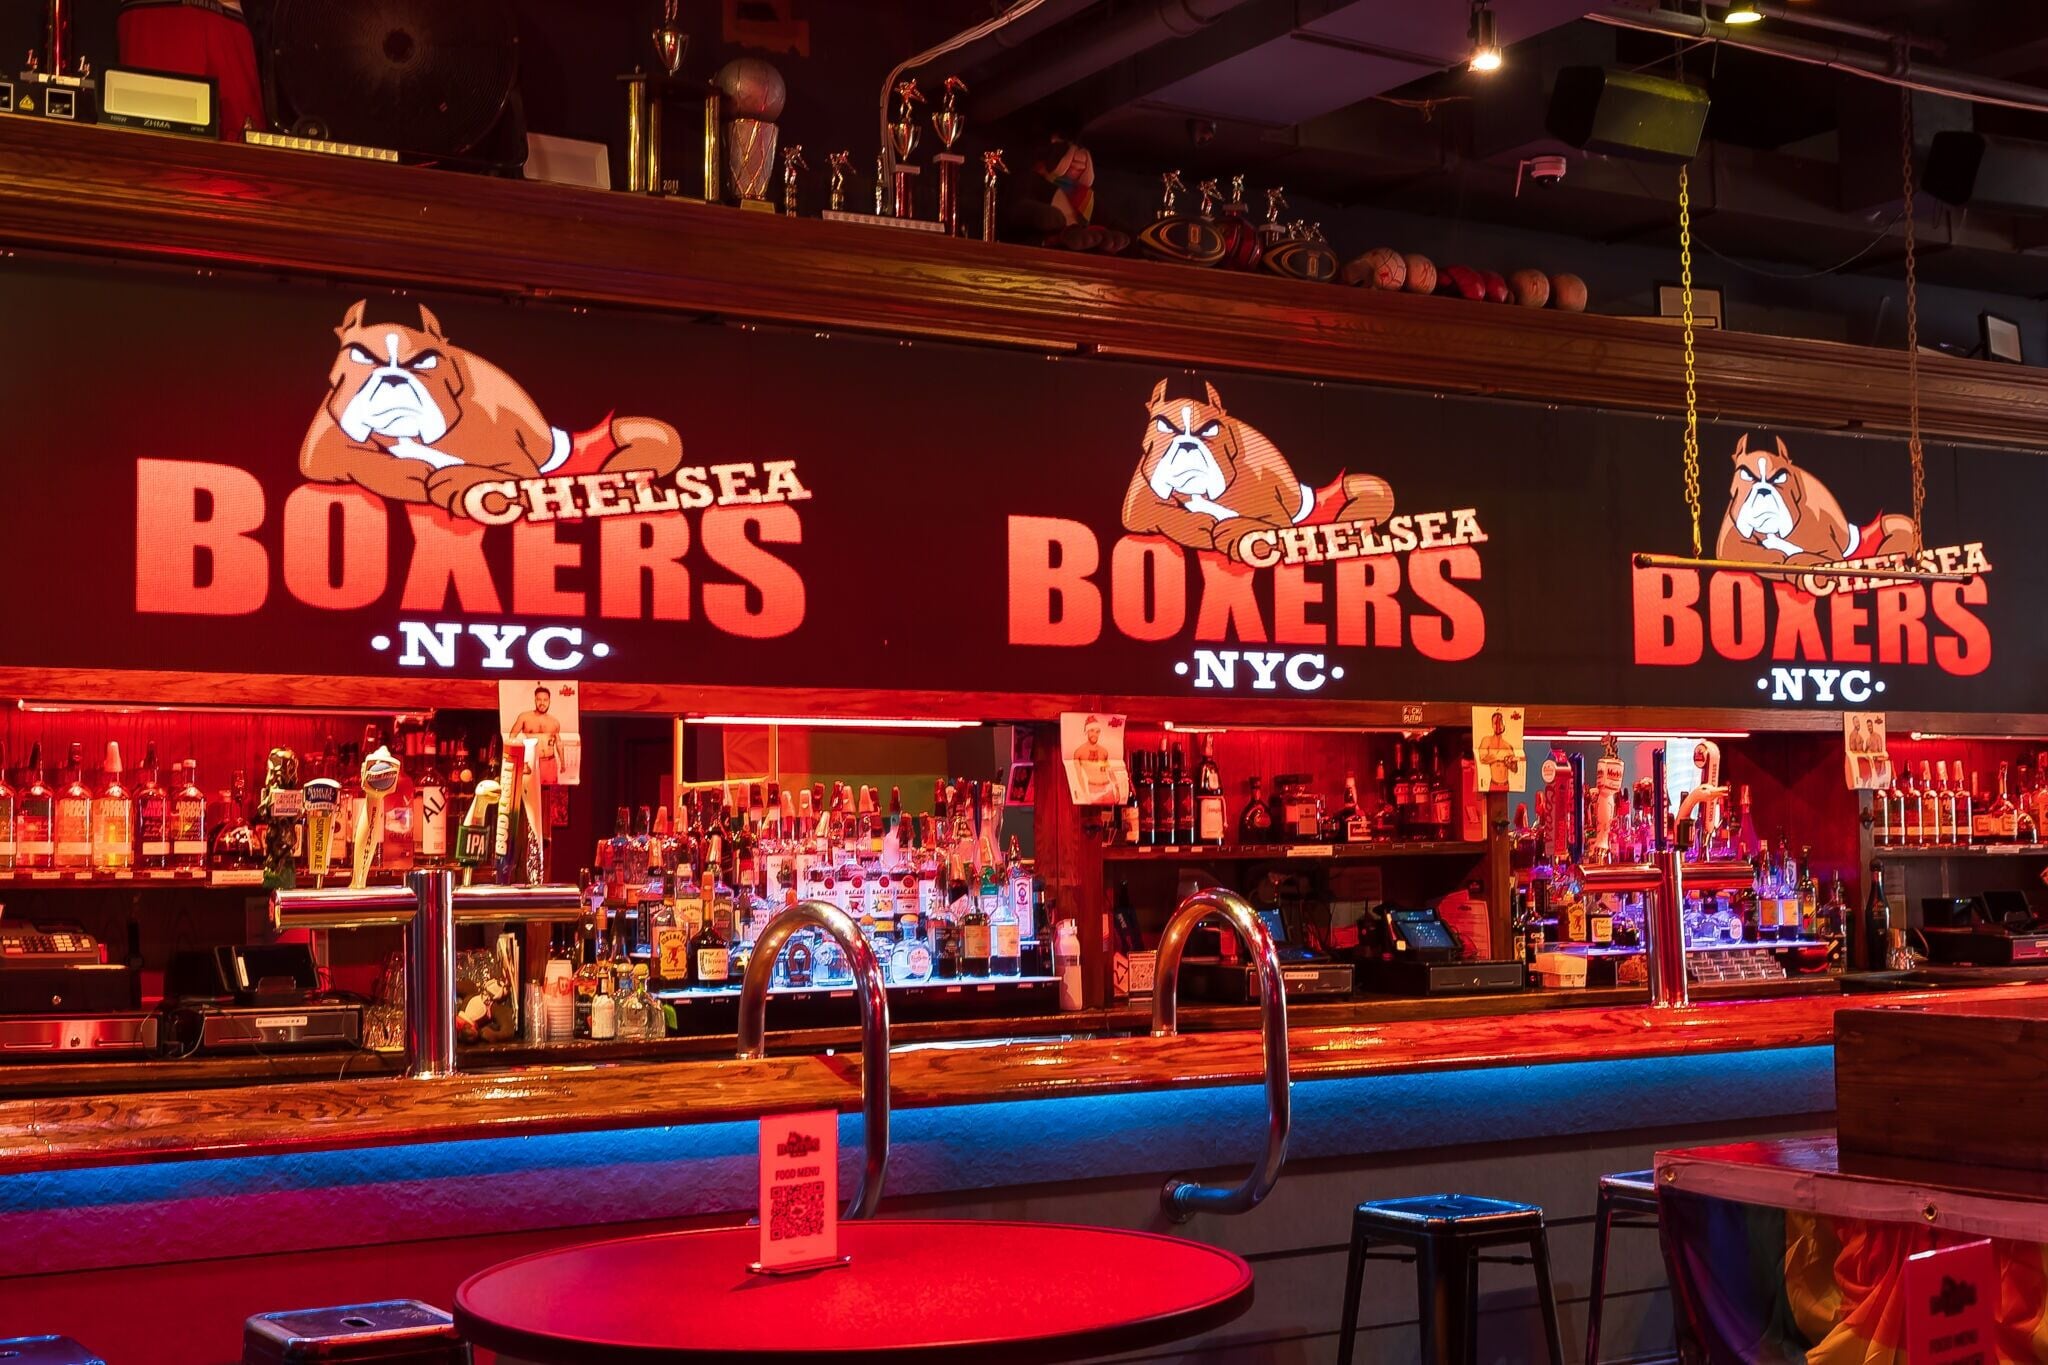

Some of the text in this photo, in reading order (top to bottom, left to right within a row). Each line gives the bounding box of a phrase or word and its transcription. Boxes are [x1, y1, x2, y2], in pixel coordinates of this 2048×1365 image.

[464, 460, 812, 526] CHELSEA
[136, 457, 805, 638] BOXERS
[1238, 508, 1488, 568] CHELSEA
[1008, 515, 1485, 661] BOXERS
[1632, 553, 1992, 677] BOXERS
[398, 621, 585, 670] NYC
[1192, 650, 1328, 691] NYC
[1771, 668, 1872, 702] NYC
[495, 760, 515, 856] BUD LIGHT
[465, 833, 485, 855] IPA
[775, 1165, 821, 1181] FOOD MENU
